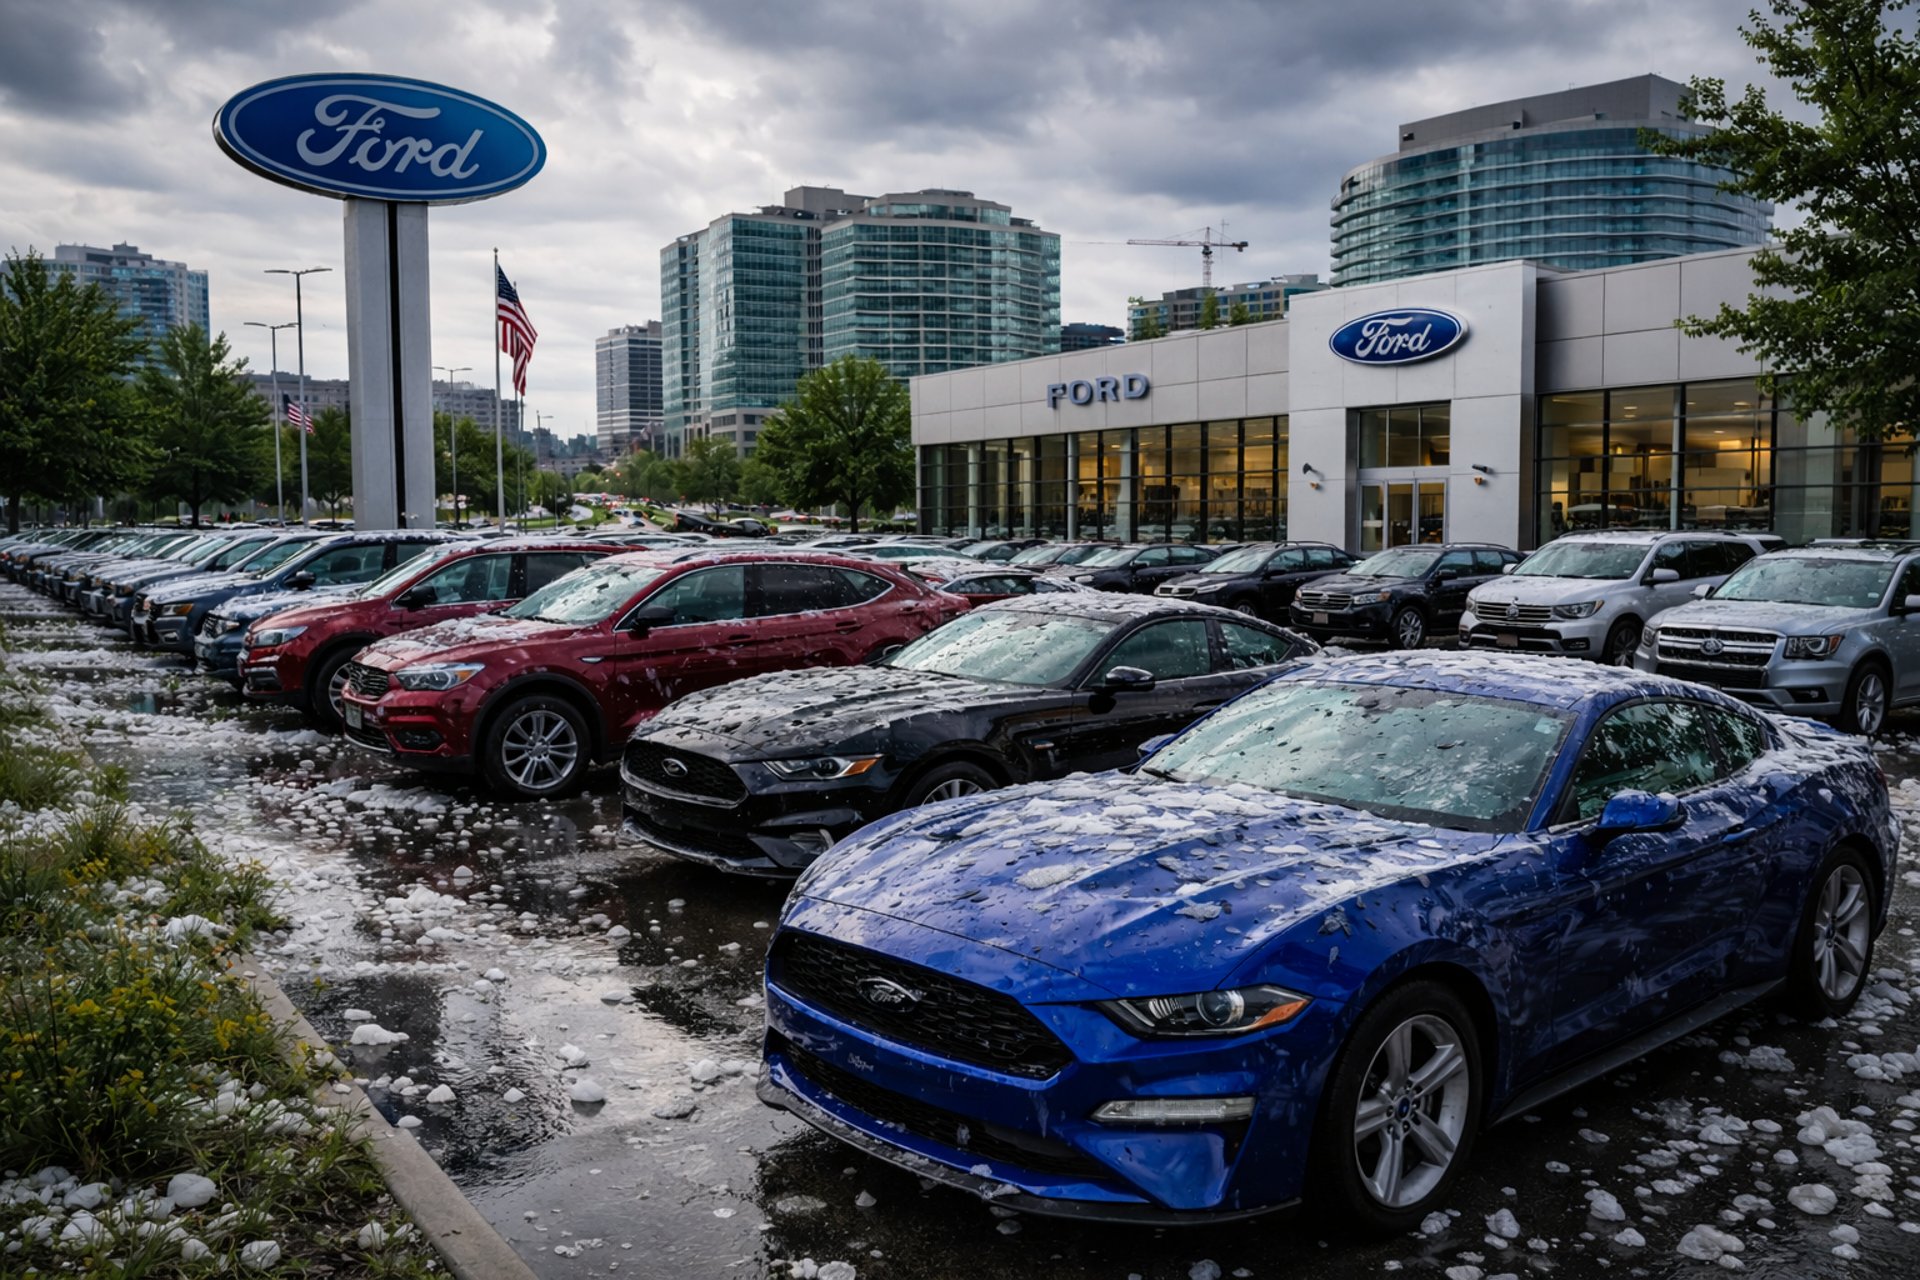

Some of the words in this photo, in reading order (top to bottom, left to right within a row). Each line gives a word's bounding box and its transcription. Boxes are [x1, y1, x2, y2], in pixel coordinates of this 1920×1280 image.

[296, 94, 484, 180] Ford
[1354, 316, 1432, 358] Ford
[1047, 373, 1150, 409] FORD
